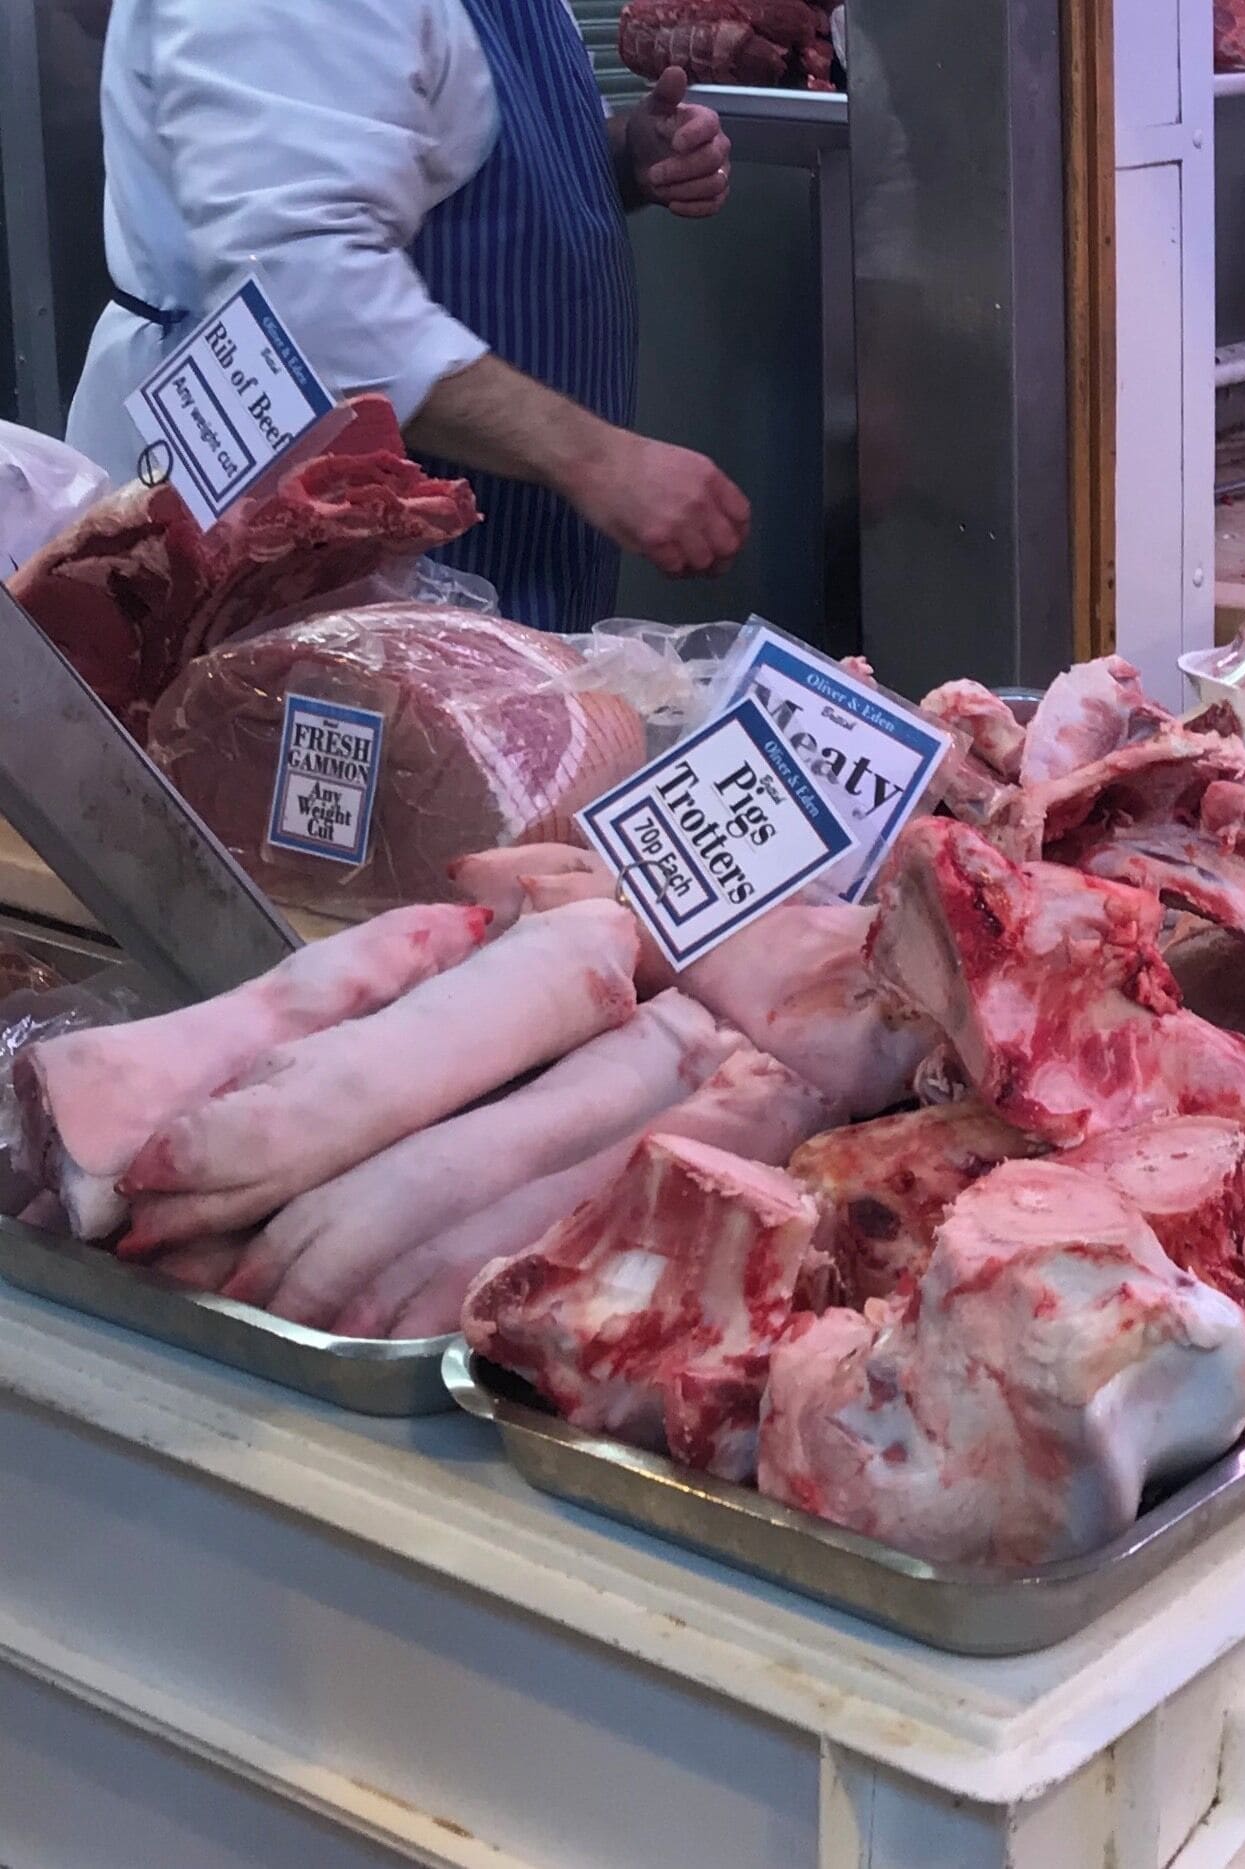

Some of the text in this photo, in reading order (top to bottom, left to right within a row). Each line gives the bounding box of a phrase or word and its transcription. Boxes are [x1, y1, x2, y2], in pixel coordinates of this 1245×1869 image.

[204, 321, 237, 369] Rib
[231, 369, 258, 396] of
[248, 391, 296, 450] Beef
[173, 376, 239, 478] Any weight cut
[806, 672, 847, 706] Oliver
[848, 699, 860, 711] &
[861, 703, 895, 733] Eden
[288, 751, 370, 784] GAMMON
[293, 723, 372, 763] FRESH
[297, 795, 352, 826] Weight
[311, 781, 342, 803] Any
[713, 760, 776, 845] Pigs
[763, 740, 792, 777] Oliver
[788, 774, 800, 787] &
[795, 784, 819, 818] Eden
[307, 818, 335, 841] Cut
[634, 817, 692, 897] 70p Each
[656, 760, 755, 904] Trotters
